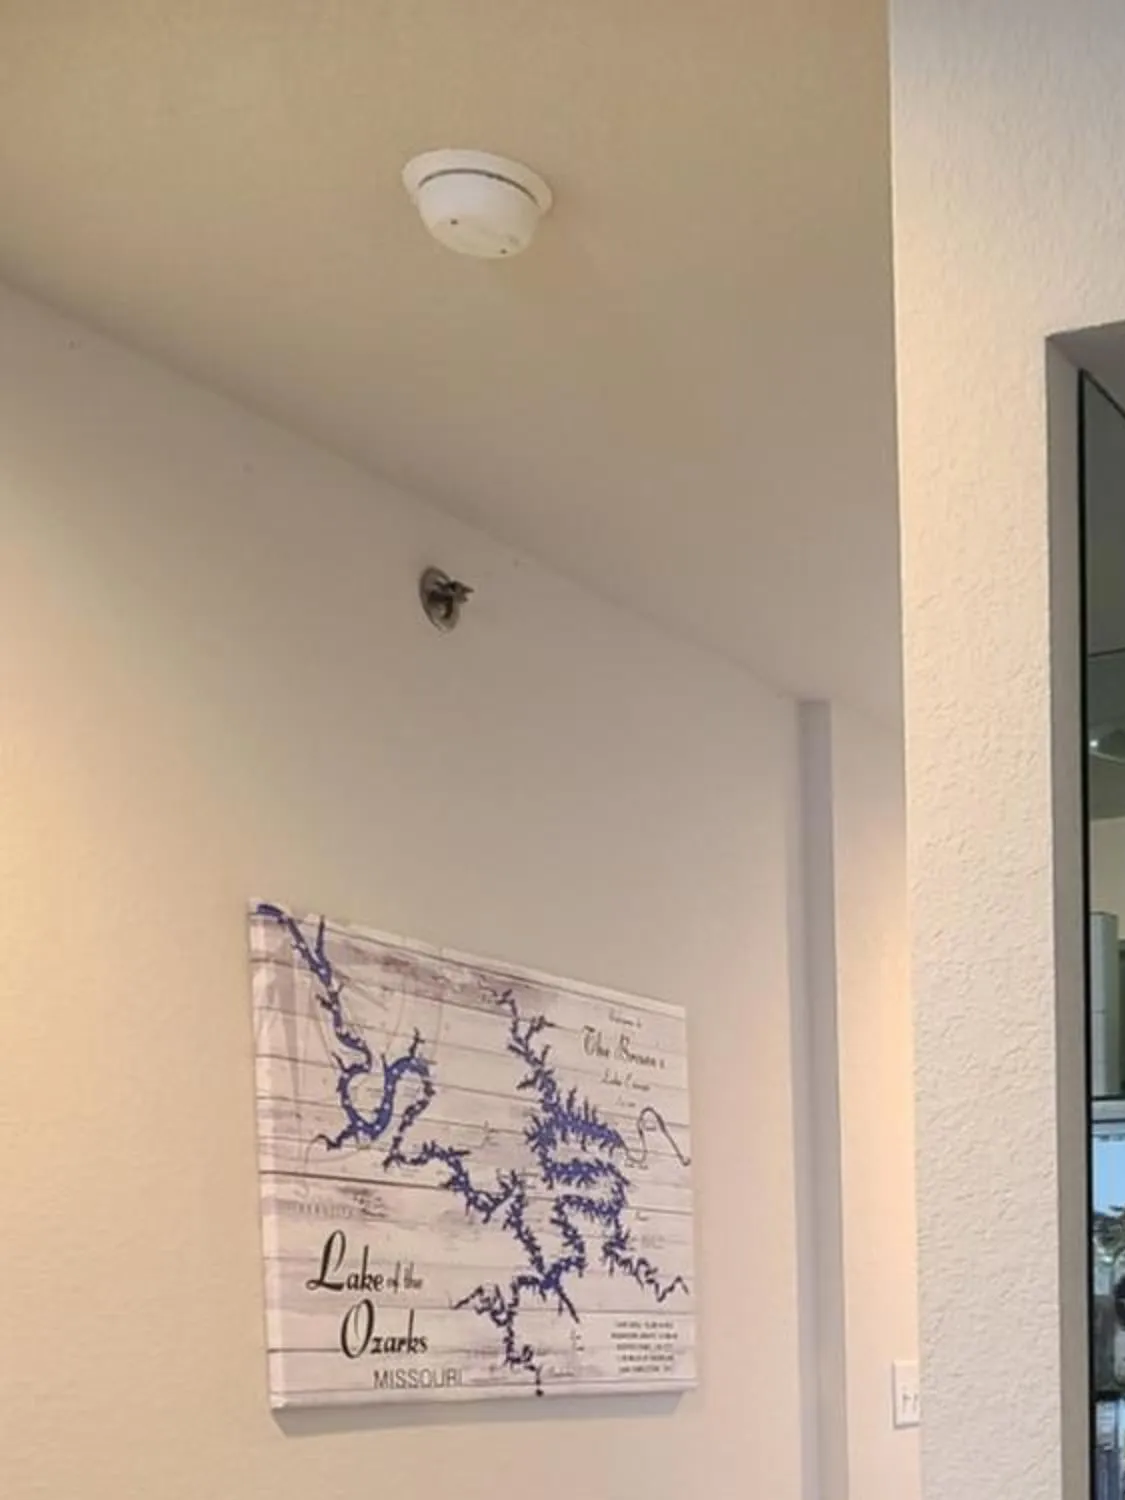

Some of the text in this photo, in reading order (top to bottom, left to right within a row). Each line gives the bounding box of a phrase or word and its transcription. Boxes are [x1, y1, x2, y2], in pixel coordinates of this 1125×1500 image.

[305, 1228, 425, 1294] Lake of the
[340, 1298, 429, 1360] Ozarks
[371, 1366, 463, 1391] MISSOURI
